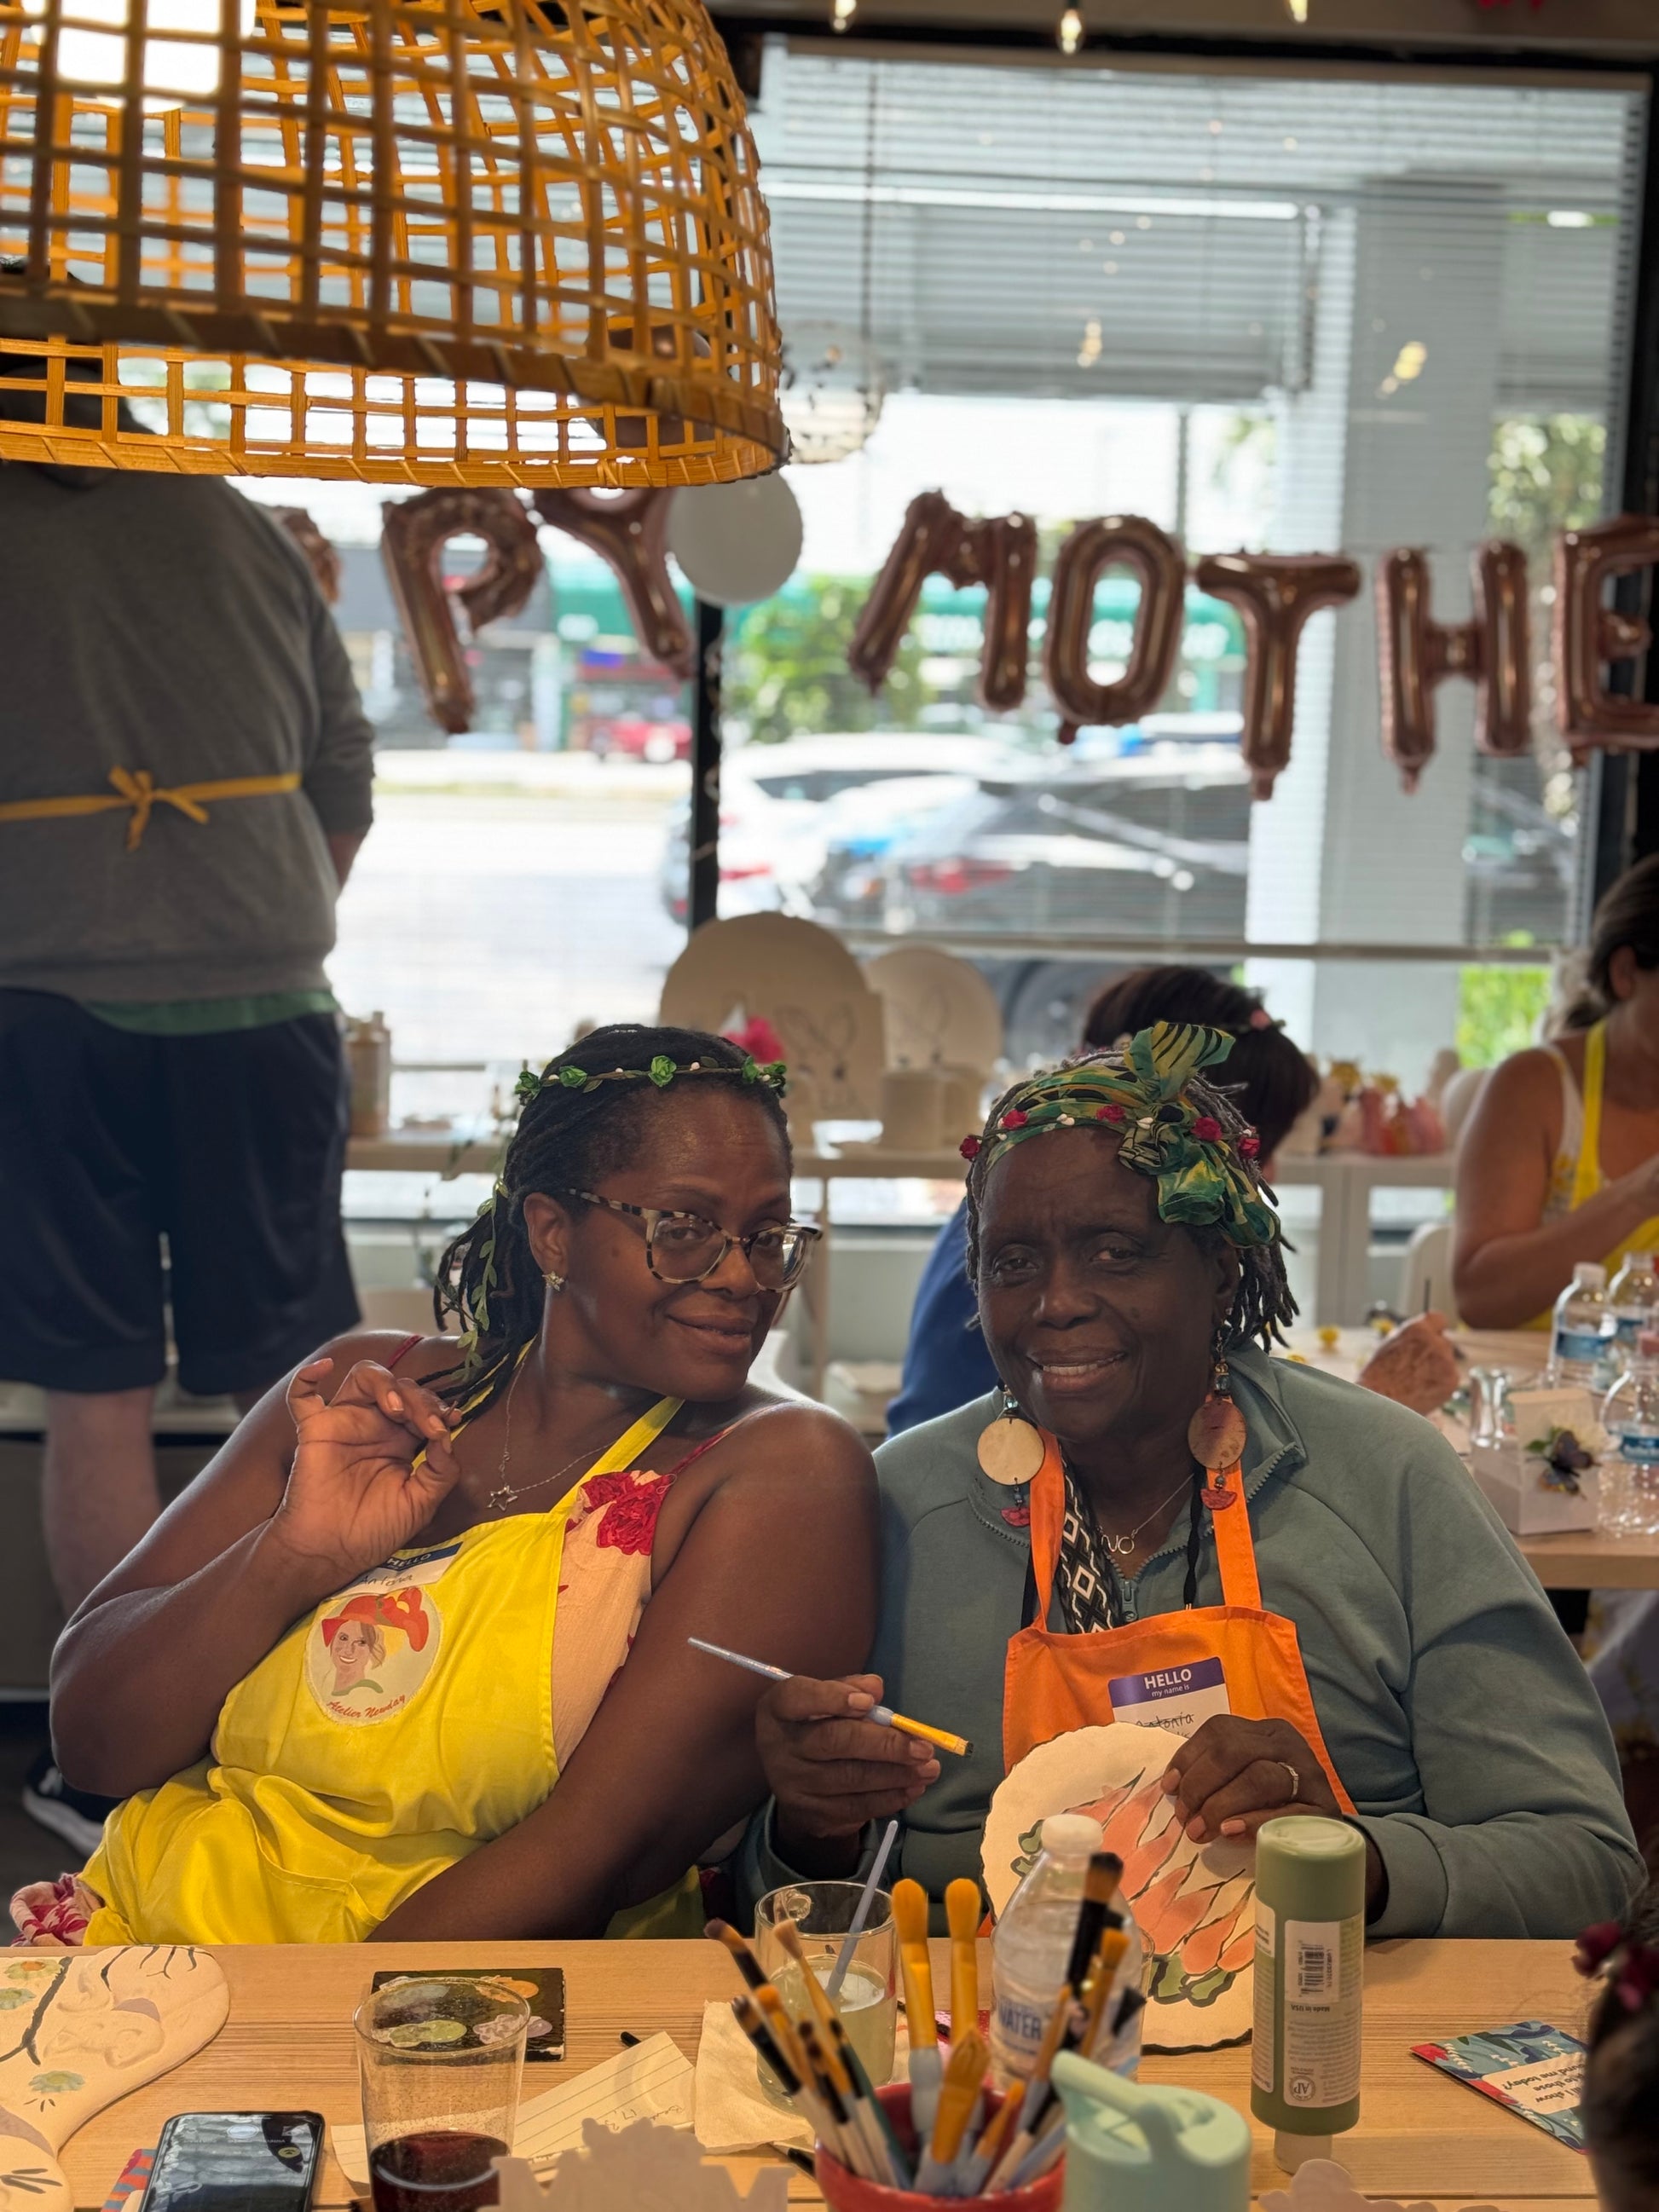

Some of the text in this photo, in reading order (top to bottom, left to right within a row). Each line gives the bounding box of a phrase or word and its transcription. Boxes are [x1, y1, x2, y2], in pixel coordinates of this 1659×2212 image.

[850, 488, 1659, 800] MOTHE
[1143, 1668, 1192, 1689] HELLO
[1151, 1683, 1190, 1698] my name is
[326, 1701, 361, 1718] Atelier
[1291, 2003, 1304, 2012] USA
[1540, 2070, 1558, 2079] me
[1501, 2075, 1542, 2090] today?
[1532, 2079, 1566, 2092] those
[1535, 2090, 1565, 2103] show
